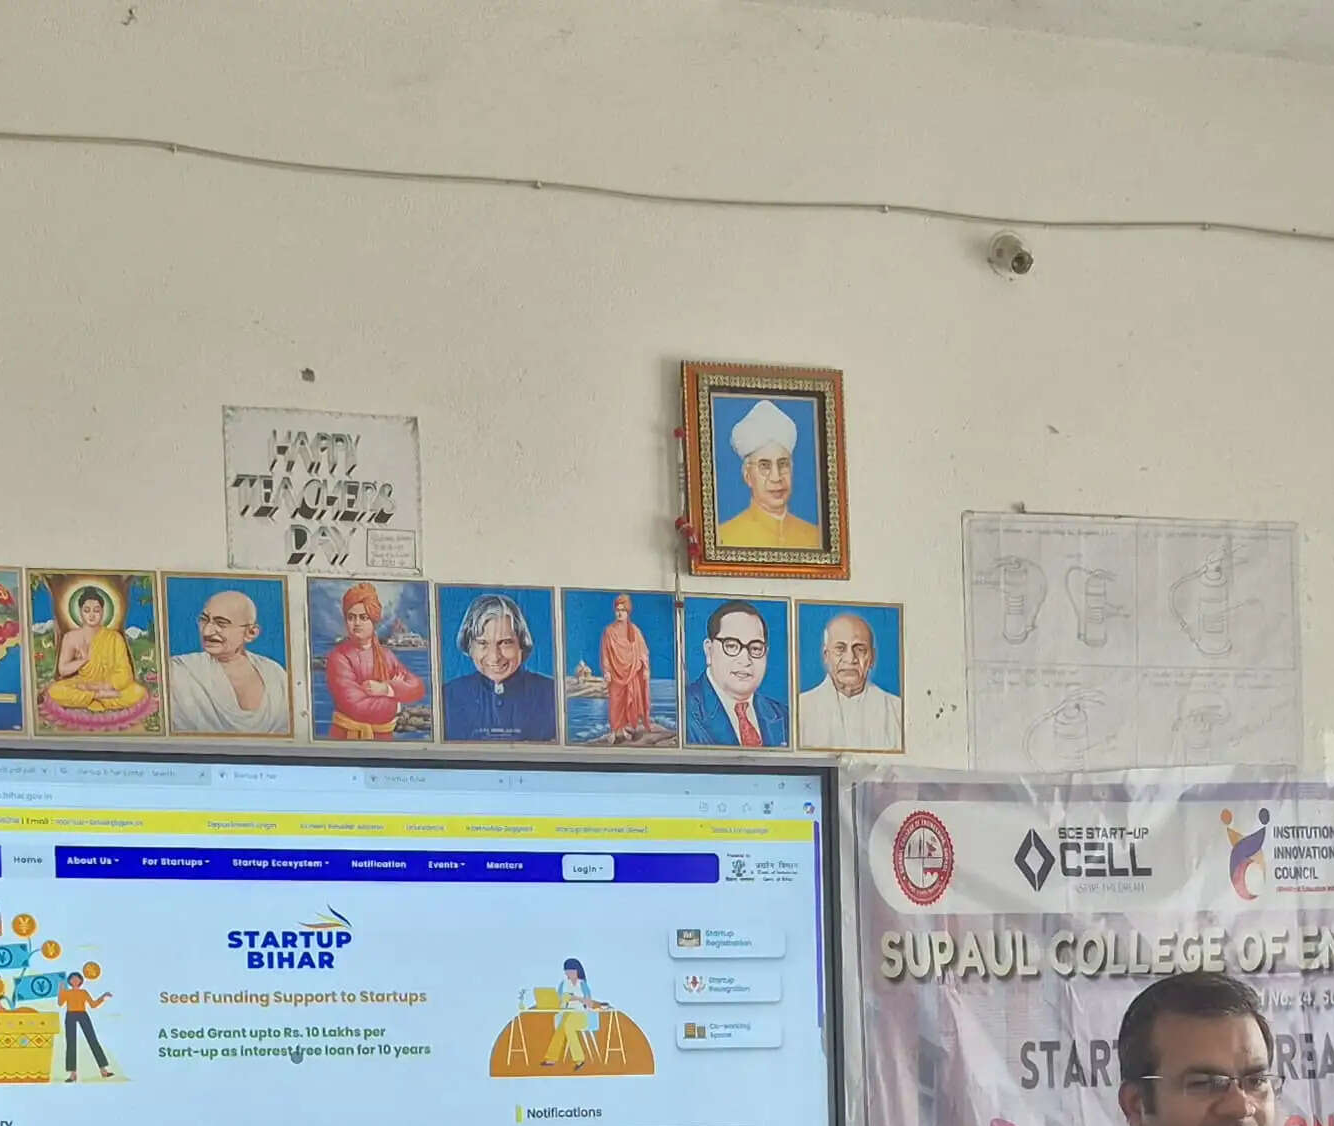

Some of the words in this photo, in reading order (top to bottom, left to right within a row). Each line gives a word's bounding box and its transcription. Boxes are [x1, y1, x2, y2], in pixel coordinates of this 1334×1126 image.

[269, 429, 361, 476] HAPPY
[232, 473, 395, 524] TEACHERS
[285, 523, 357, 565] DAY
[1058, 827, 1083, 839] SCE
[1085, 826, 1149, 839] START-UP
[13, 856, 43, 864] Home
[67, 856, 92, 865] About
[93, 857, 112, 865] Us
[142, 857, 158, 866] For
[161, 857, 204, 868] Startups
[232, 858, 269, 869] Startup
[271, 859, 323, 870] Ecosystem
[351, 859, 407, 869] Notification
[428, 860, 458, 869] Events
[486, 861, 524, 870] Mentors
[1059, 842, 1153, 877] CELL
[573, 865, 597, 876] Login
[1274, 866, 1319, 880] COUNCIL
[227, 930, 353, 949] STARTUP
[879, 930, 1039, 979] SUPAUL
[1050, 925, 1225, 976] COLLEGE
[1237, 926, 1289, 973] OF
[247, 951, 335, 969] BIHAR
[159, 990, 200, 1004] Seed
[204, 990, 269, 1007] Funding
[273, 989, 338, 1007] Support
[340, 990, 357, 1003] to
[359, 989, 427, 1006] Startups
[158, 1028, 168, 1039] A
[170, 1027, 205, 1039] Seed
[207, 1028, 247, 1039] Grant
[249, 1027, 281, 1041] upto
[283, 1027, 304, 1038] Rs.
[305, 1026, 319, 1038] 10
[322, 1026, 361, 1038] Lakhs
[363, 1026, 386, 1041] per
[158, 1045, 218, 1060] Start-up
[220, 1047, 237, 1058] as
[240, 1045, 292, 1057] interest
[295, 1044, 323, 1058] free
[324, 1044, 354, 1056] loan
[356, 1044, 375, 1055] for
[377, 1043, 391, 1055] 10
[394, 1045, 431, 1059] years
[526, 1107, 602, 1119] Notifications
